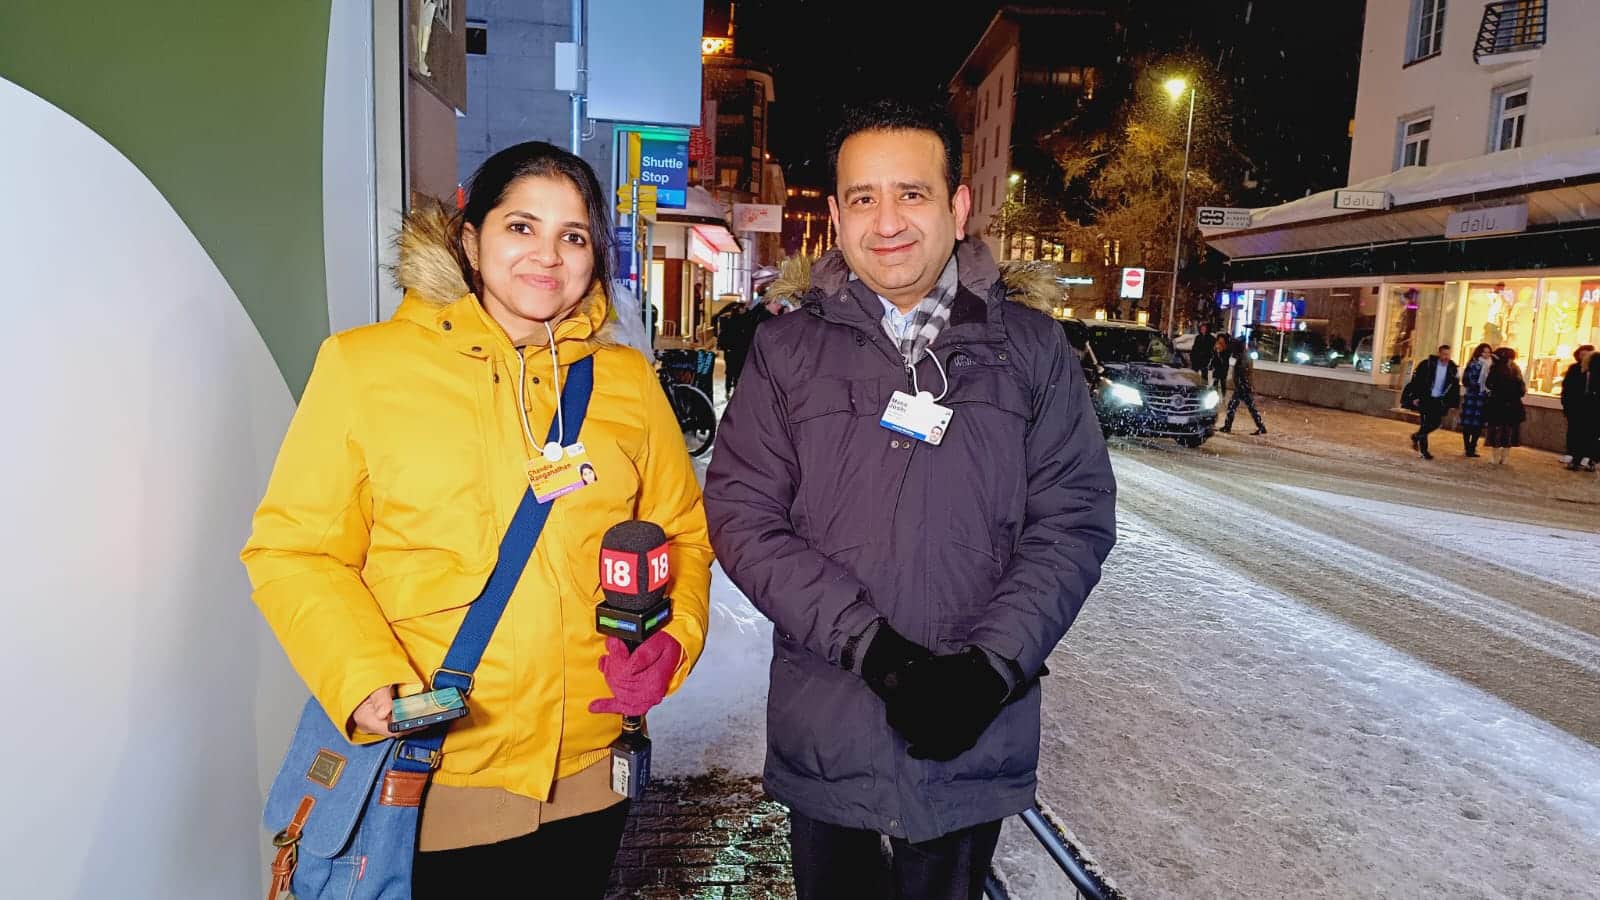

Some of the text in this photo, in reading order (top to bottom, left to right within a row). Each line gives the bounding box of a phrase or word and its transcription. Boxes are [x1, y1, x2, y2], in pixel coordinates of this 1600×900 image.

[642, 156, 684, 168] Shuttle
[641, 171, 670, 185] Stop
[1343, 195, 1376, 206] dalu
[1461, 215, 1496, 232] dalu
[604, 558, 631, 587] 18
[651, 553, 669, 583] 18
